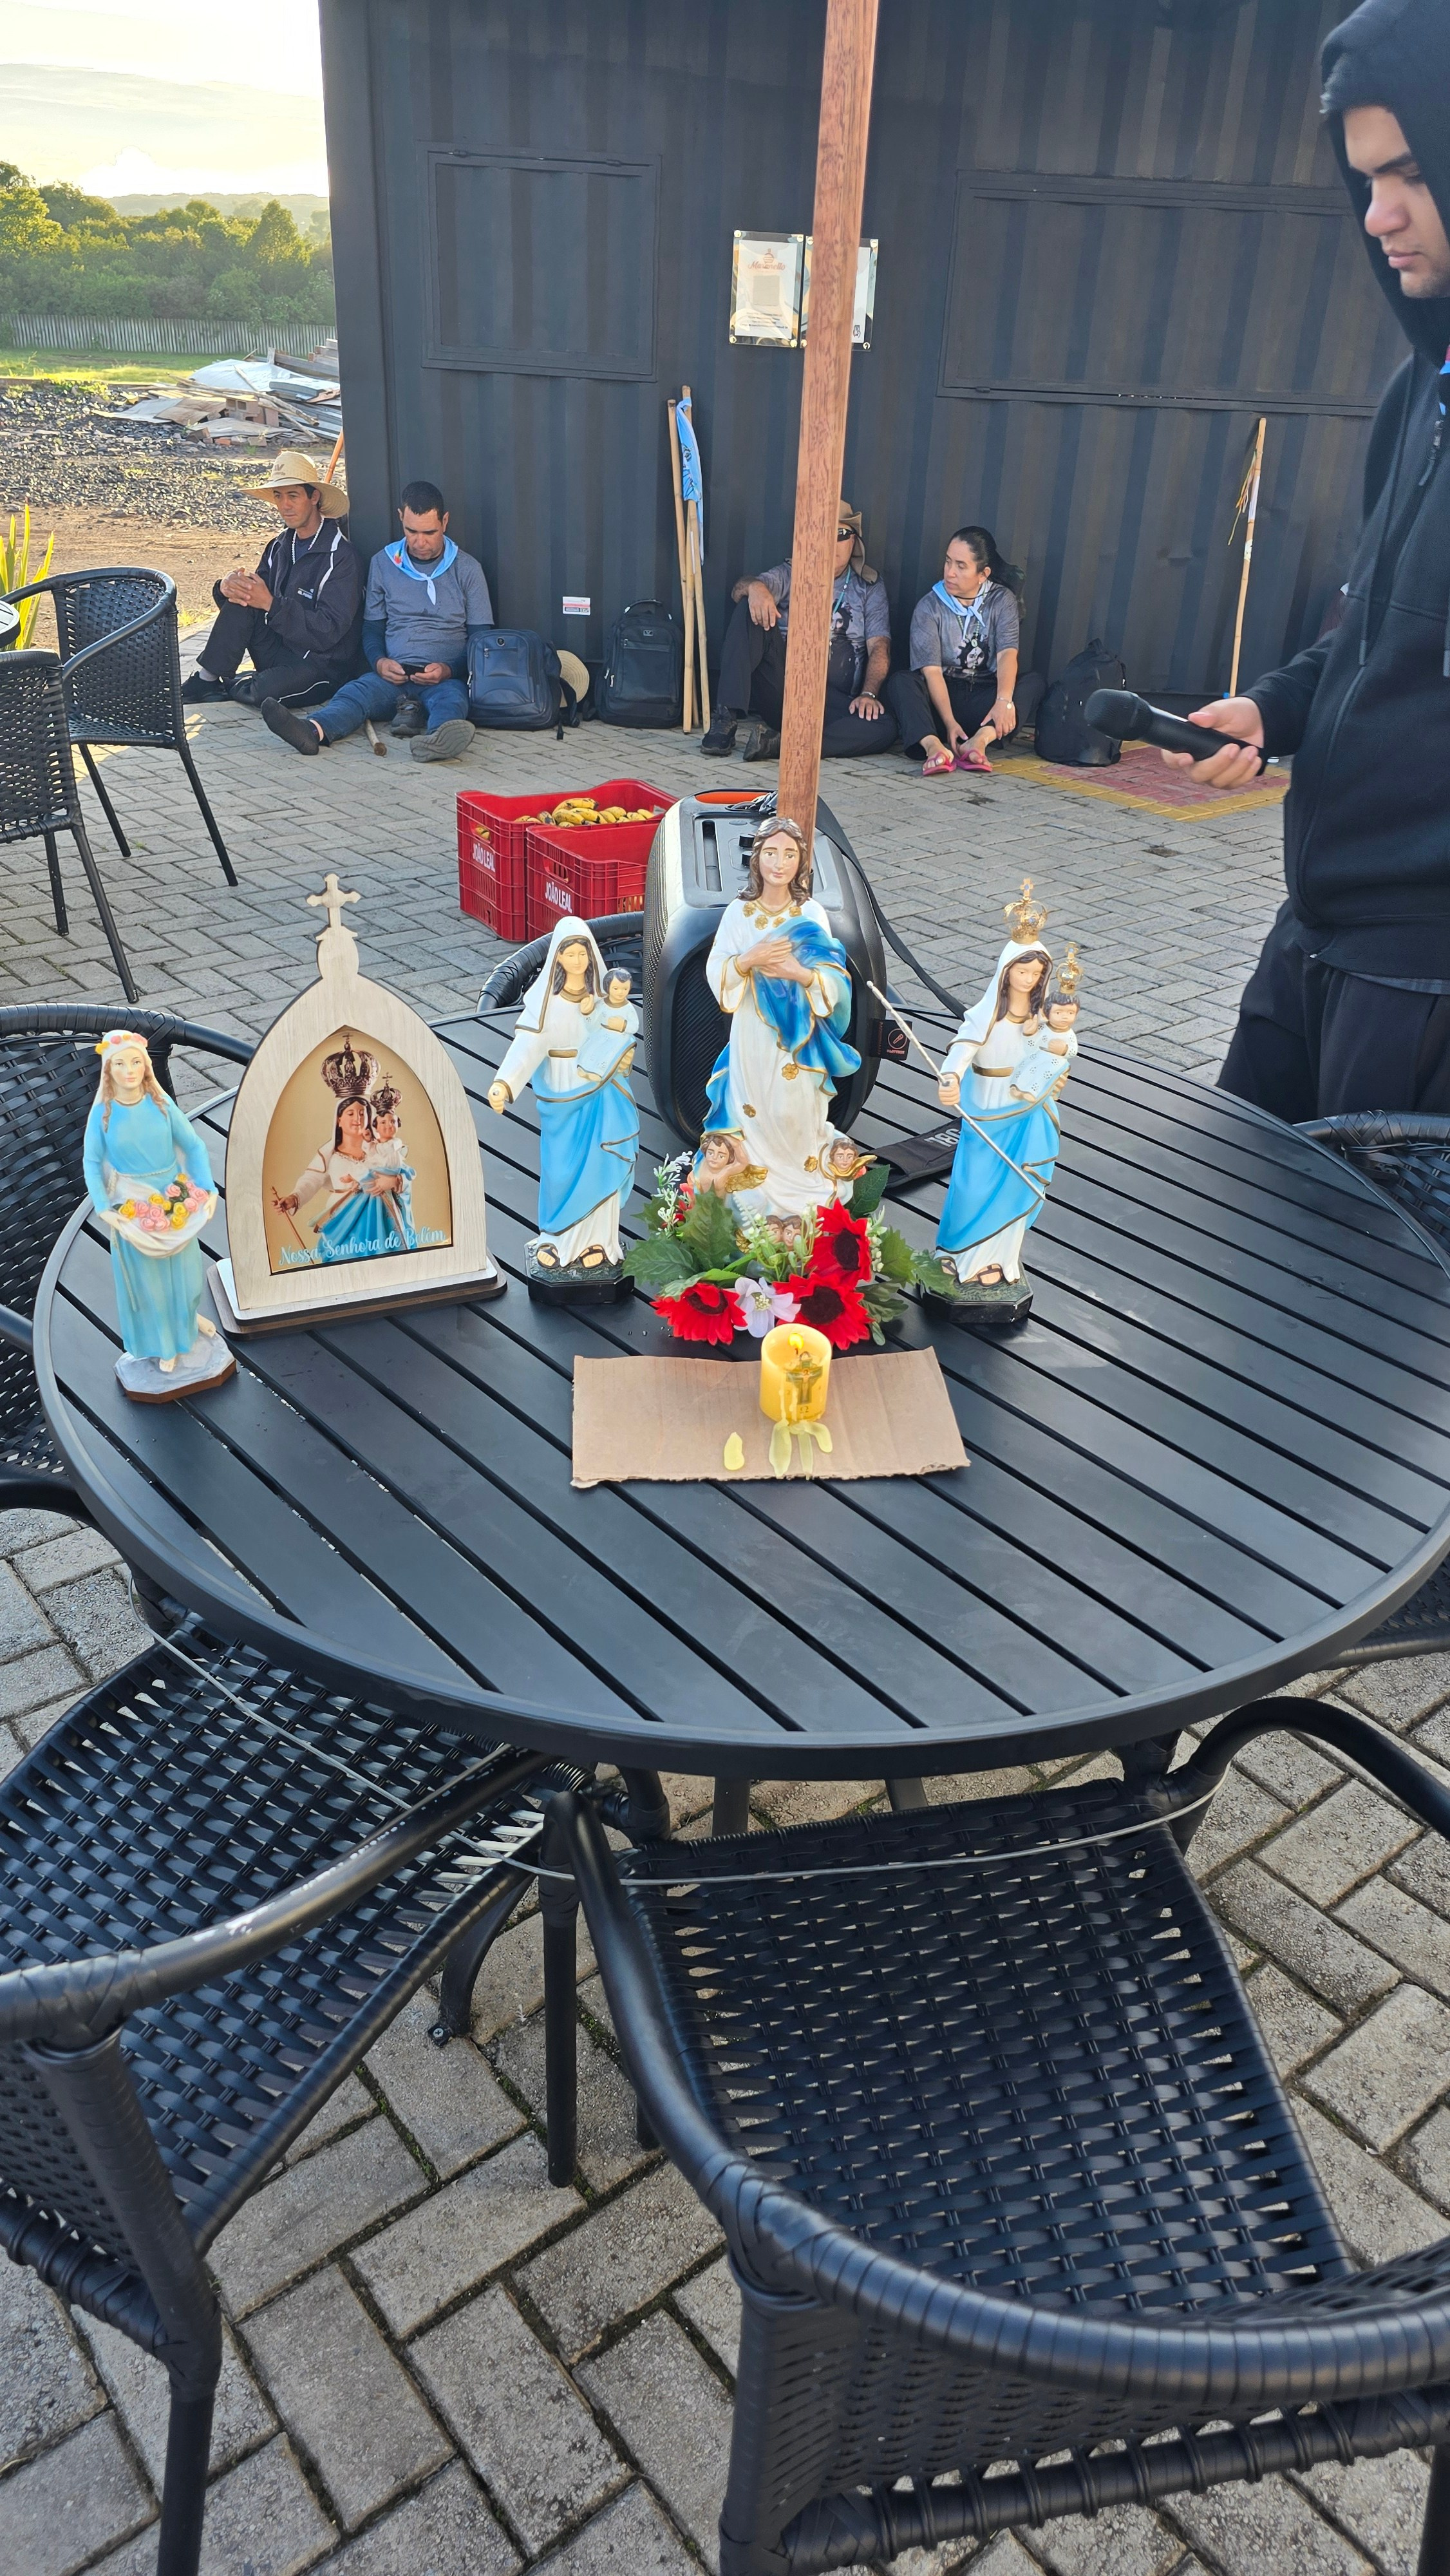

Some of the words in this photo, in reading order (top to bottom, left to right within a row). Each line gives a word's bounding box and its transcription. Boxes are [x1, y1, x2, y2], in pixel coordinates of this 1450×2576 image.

[473, 843, 483, 865] JOÃO
[484, 849, 495, 873] LEAL
[545, 881, 558, 905] JOÃO
[559, 889, 572, 914] LEAL
[924, 1128, 960, 1147] JBL
[279, 1244, 321, 1265] Nossa
[323, 1236, 382, 1258] Senhora
[384, 1231, 401, 1249] de
[404, 1226, 446, 1247] Belém
